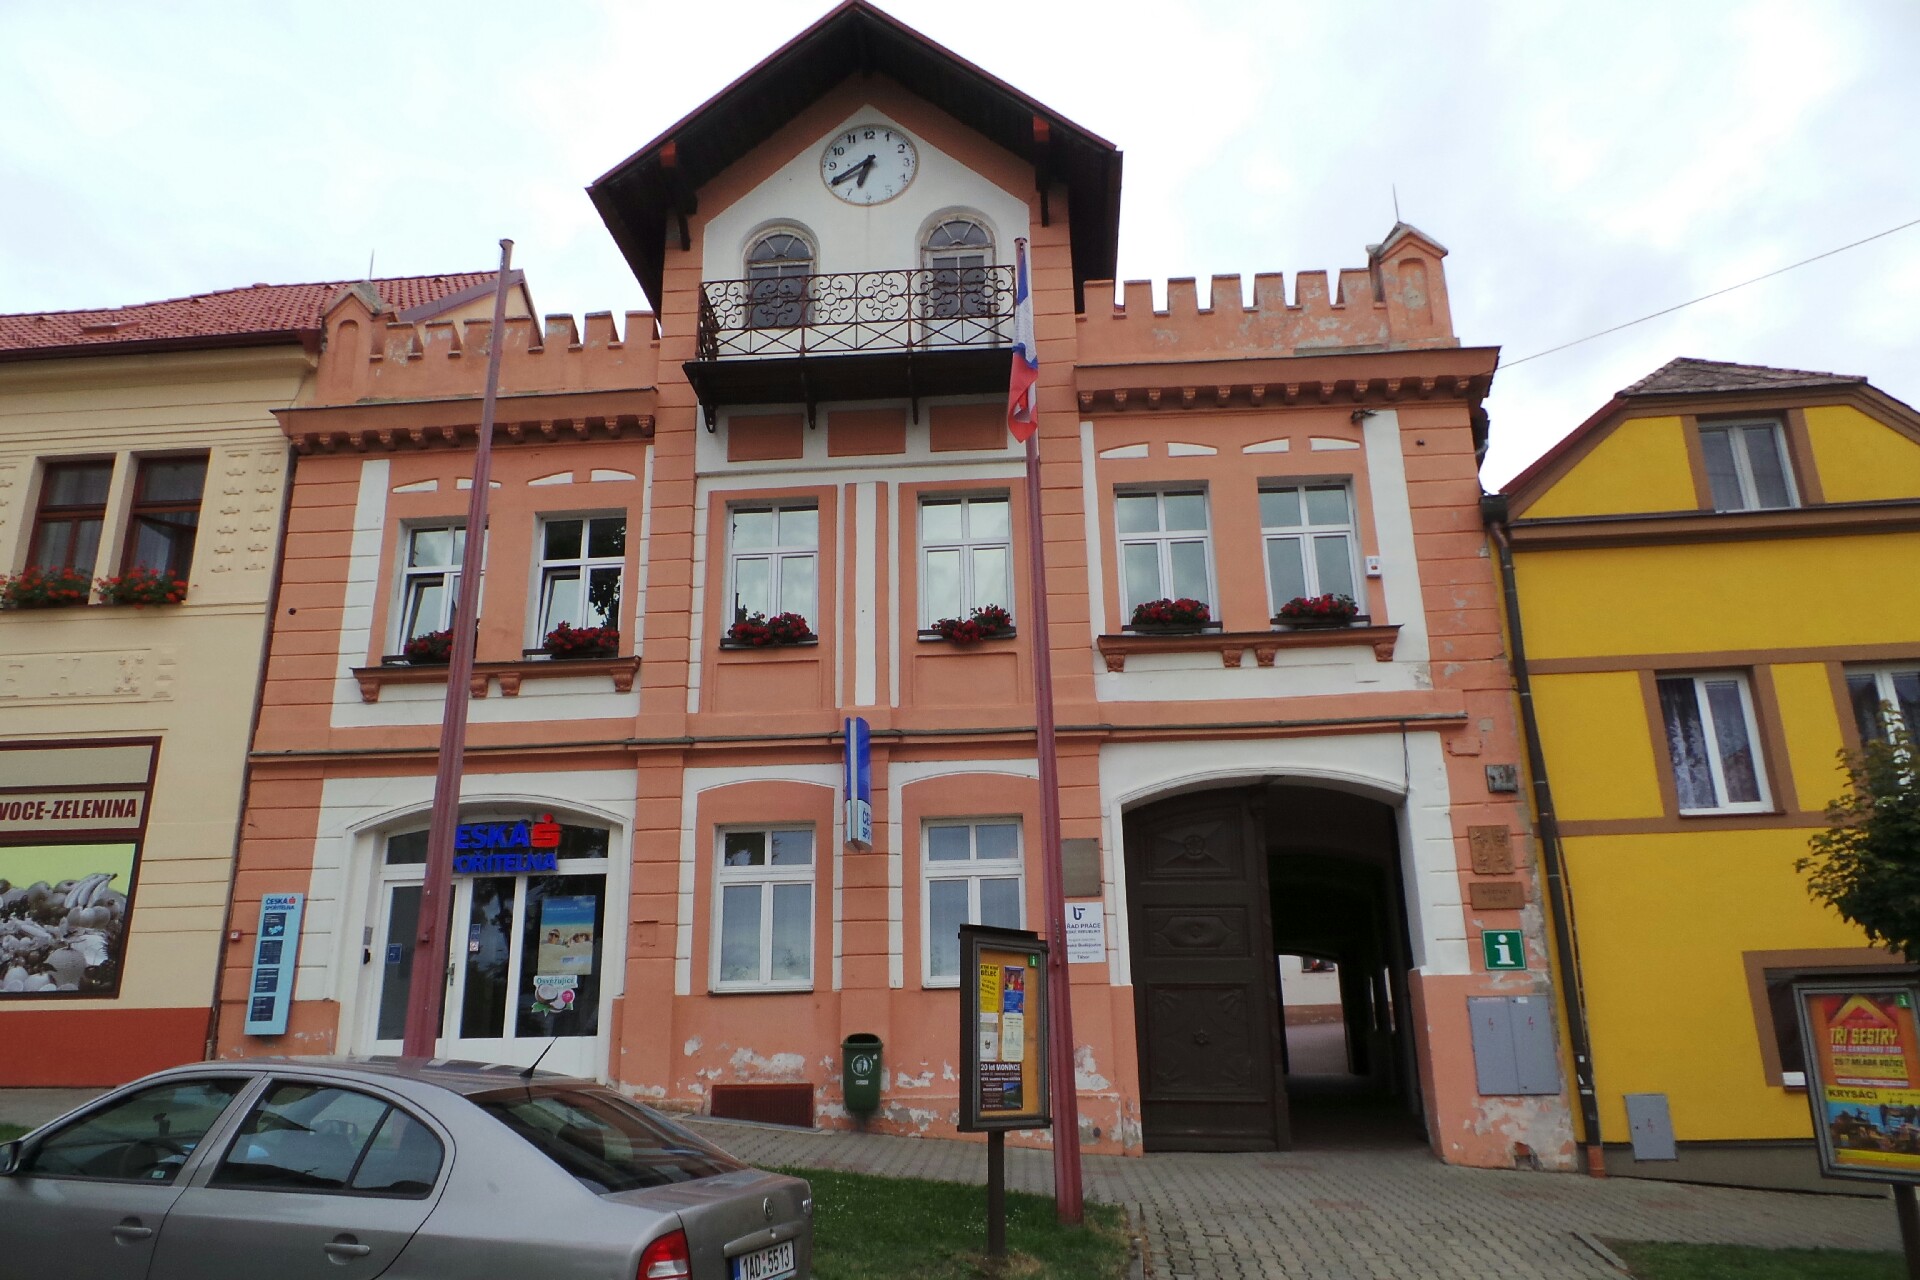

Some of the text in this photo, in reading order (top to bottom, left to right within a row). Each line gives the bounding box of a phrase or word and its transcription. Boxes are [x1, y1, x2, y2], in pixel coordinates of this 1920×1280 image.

[847, 134, 856, 143] 11
[864, 131, 875, 139] 12
[885, 133, 890, 142] 1
[833, 147, 845, 156] 10
[897, 143, 906, 153] 2
[828, 162, 837, 171] 9
[903, 157, 910, 167] 3
[455, 819, 530, 849] ESKÁ
[454, 851, 558, 873] OŘITELNA
[266, 897, 288, 905] ČESKÁ
[1851, 1028, 1897, 1045] SESTRY
[743, 1245, 790, 1280] 1AD 5513
